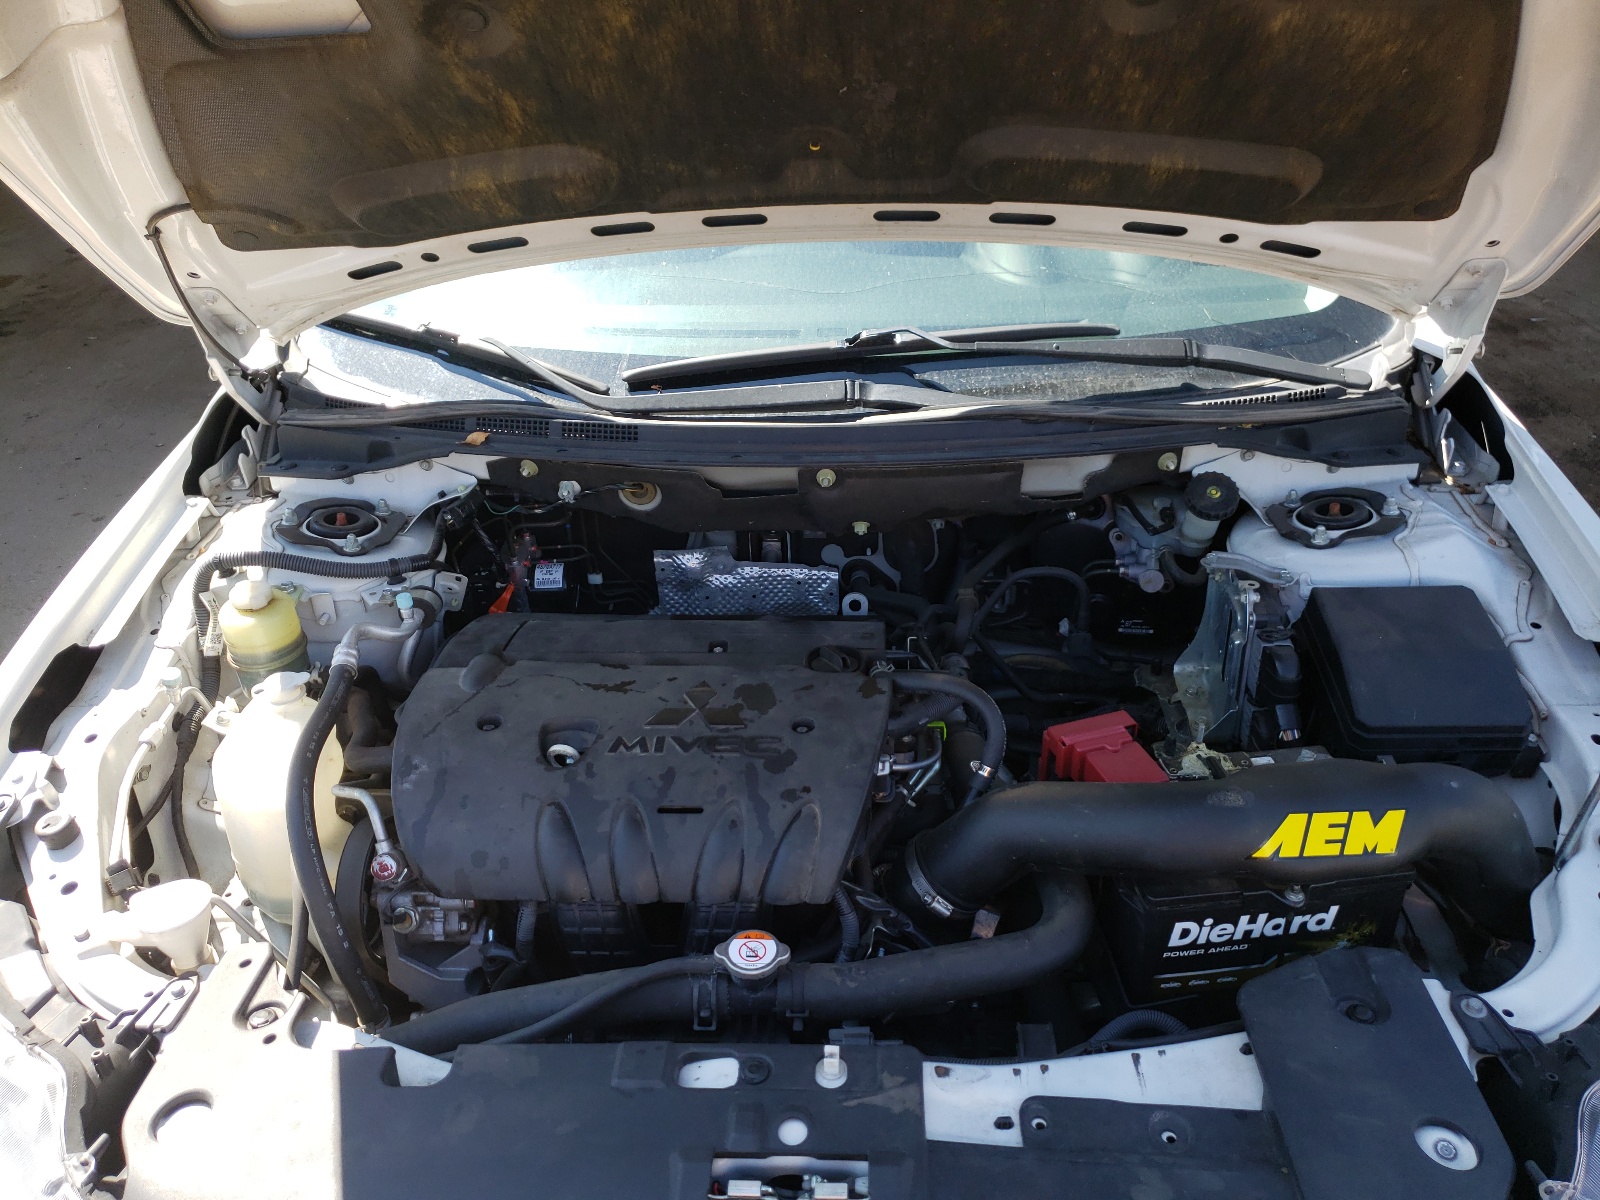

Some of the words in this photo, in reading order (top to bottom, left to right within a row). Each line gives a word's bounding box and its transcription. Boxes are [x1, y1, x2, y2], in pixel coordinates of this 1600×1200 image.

[606, 734, 783, 759] MIVEC
[1251, 809, 1406, 858] AEM
[1167, 904, 1341, 948] DieHard
[1162, 948, 1205, 958] POWER
[1207, 943, 1249, 954] AHEAD
